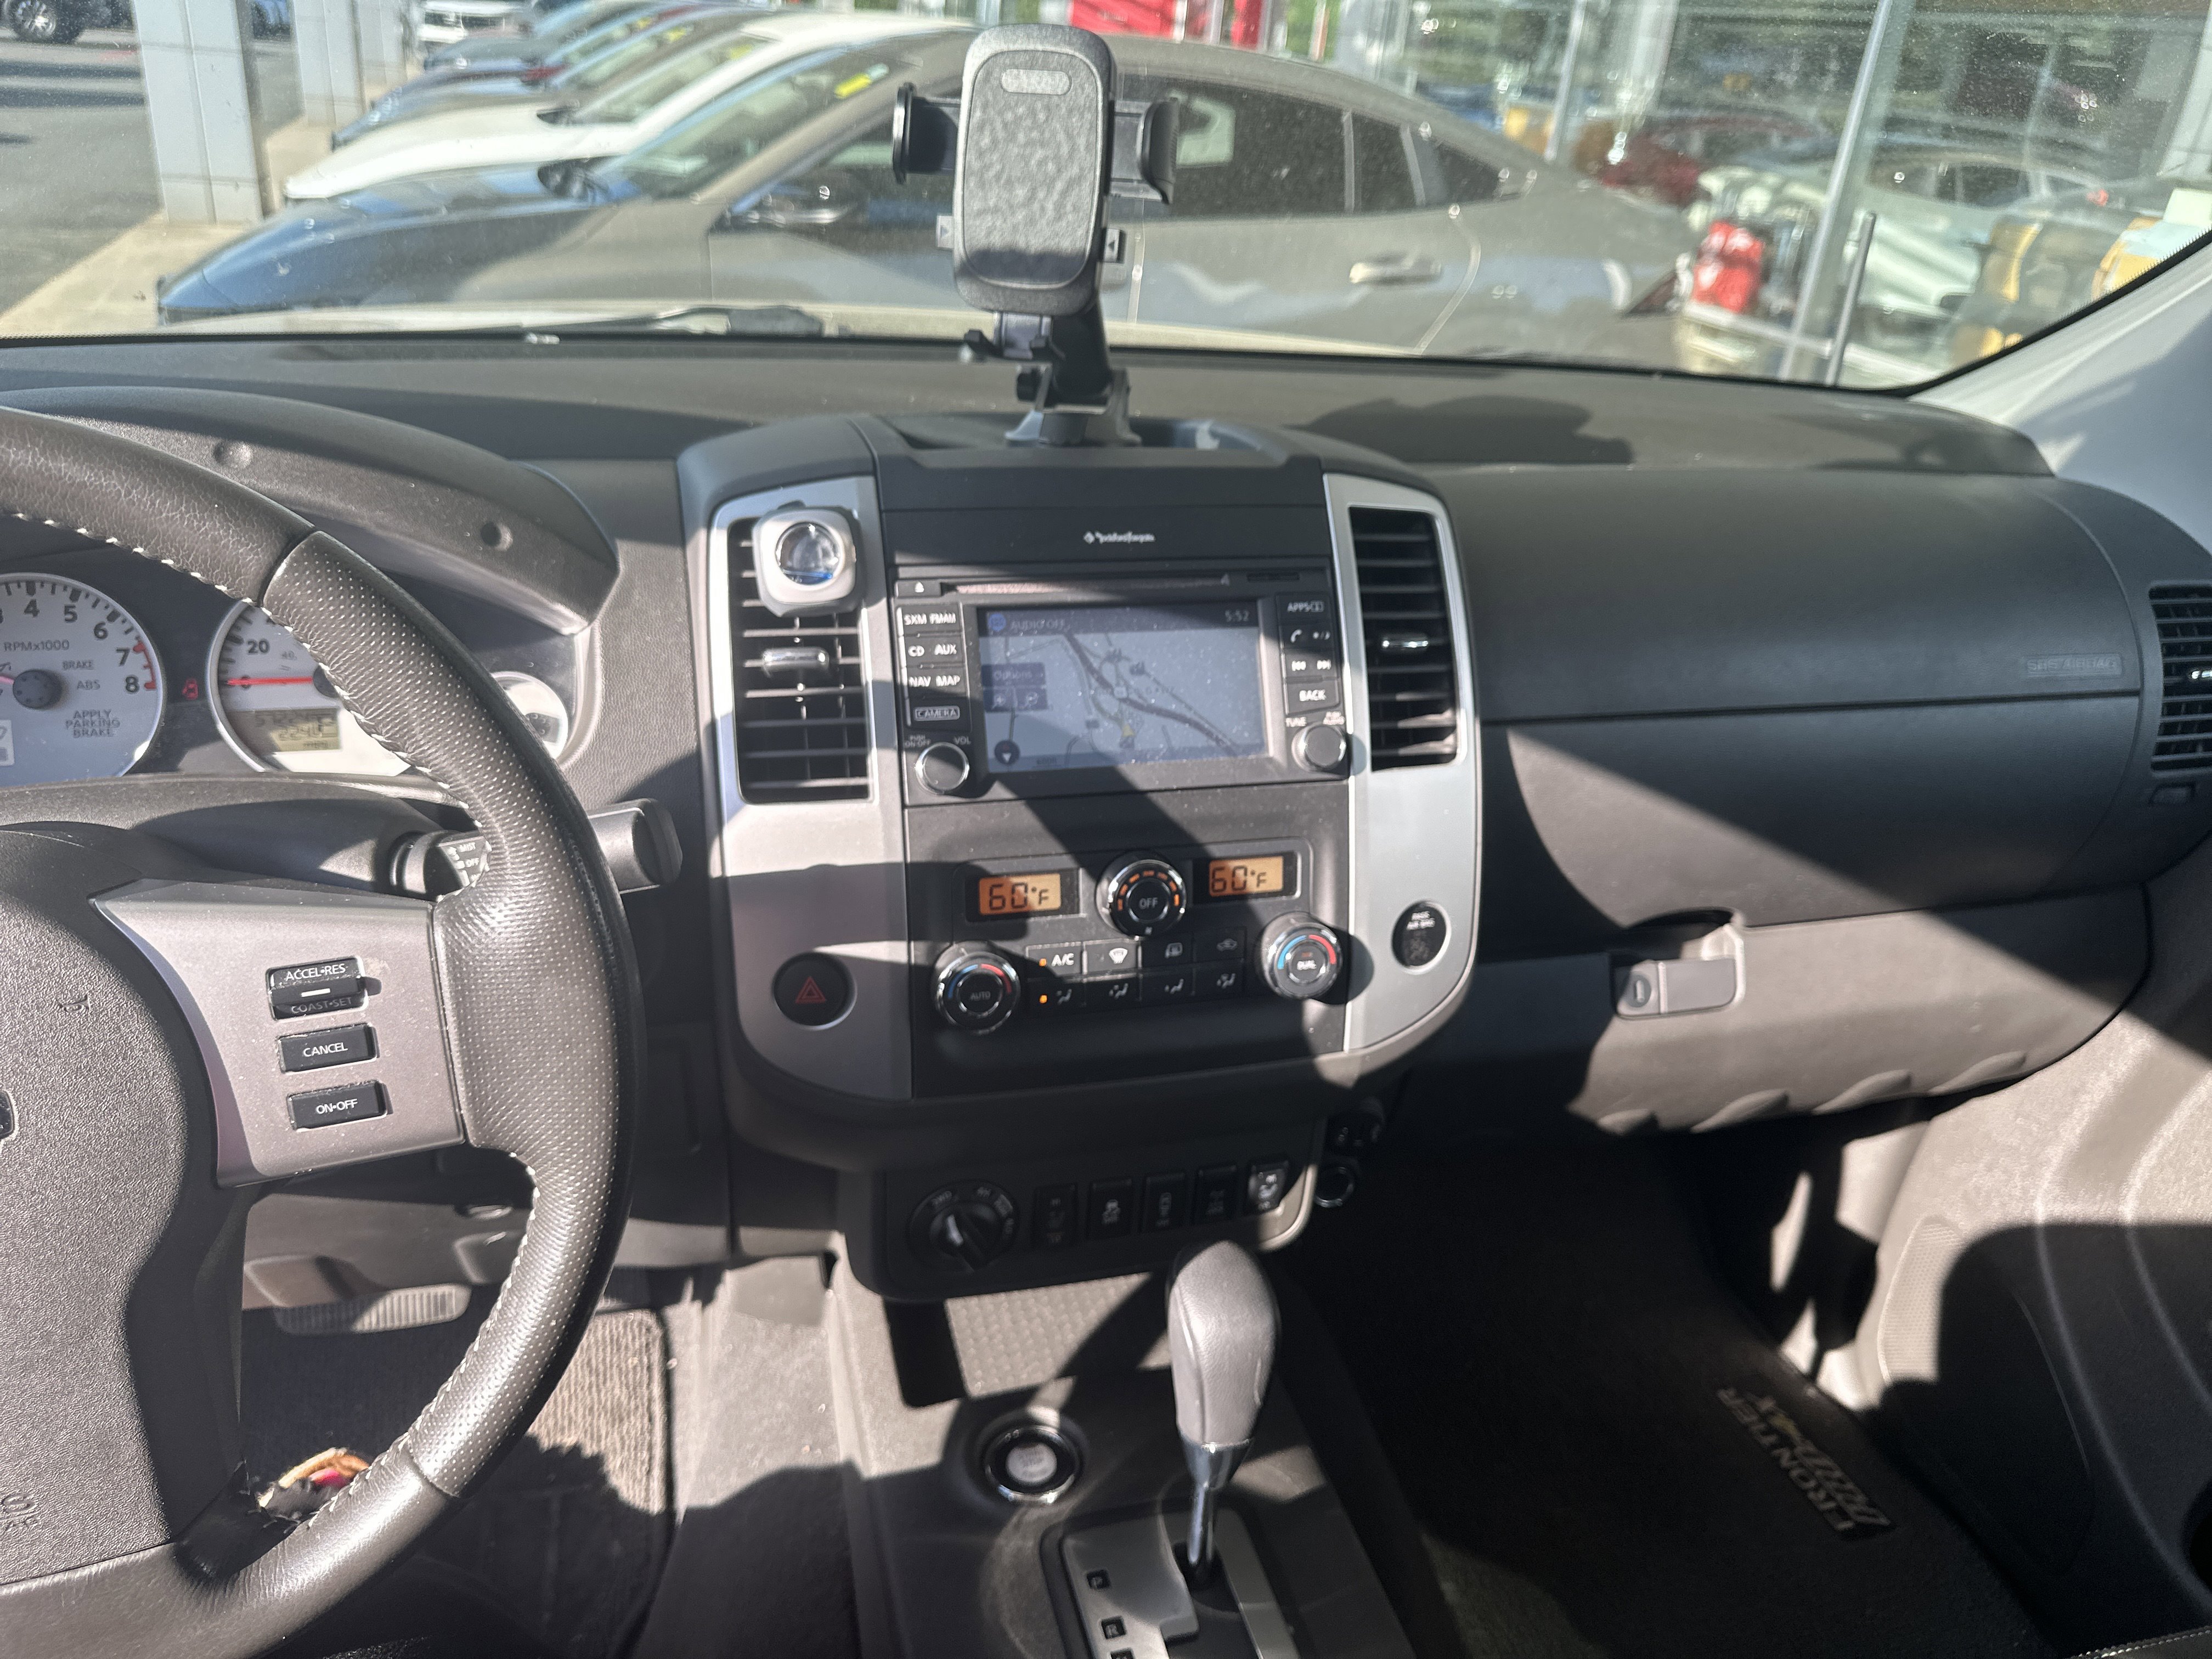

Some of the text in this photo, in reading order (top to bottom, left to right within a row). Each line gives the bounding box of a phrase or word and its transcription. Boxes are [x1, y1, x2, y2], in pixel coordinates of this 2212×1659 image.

[24, 599, 40, 617] 4
[64, 604, 78, 623] 5
[93, 622, 108, 639] 6
[4, 640, 70, 651] RPMx1000
[247, 639, 270, 655] 20
[908, 645, 925, 657] CD
[934, 644, 957, 655] AUX
[116, 647, 130, 667] 7
[62, 659, 93, 670] BRAKE
[125, 675, 140, 694] 8
[909, 676, 932, 687] NAV
[936, 675, 960, 686] MAP
[1299, 690, 1327, 702] BACK
[953, 736, 971, 745] VOL
[1139, 898, 1159, 910] OFF
[1051, 953, 1075, 967] A/C
[970, 991, 991, 1001] AUTO
[303, 1042, 348, 1058] CANCEL
